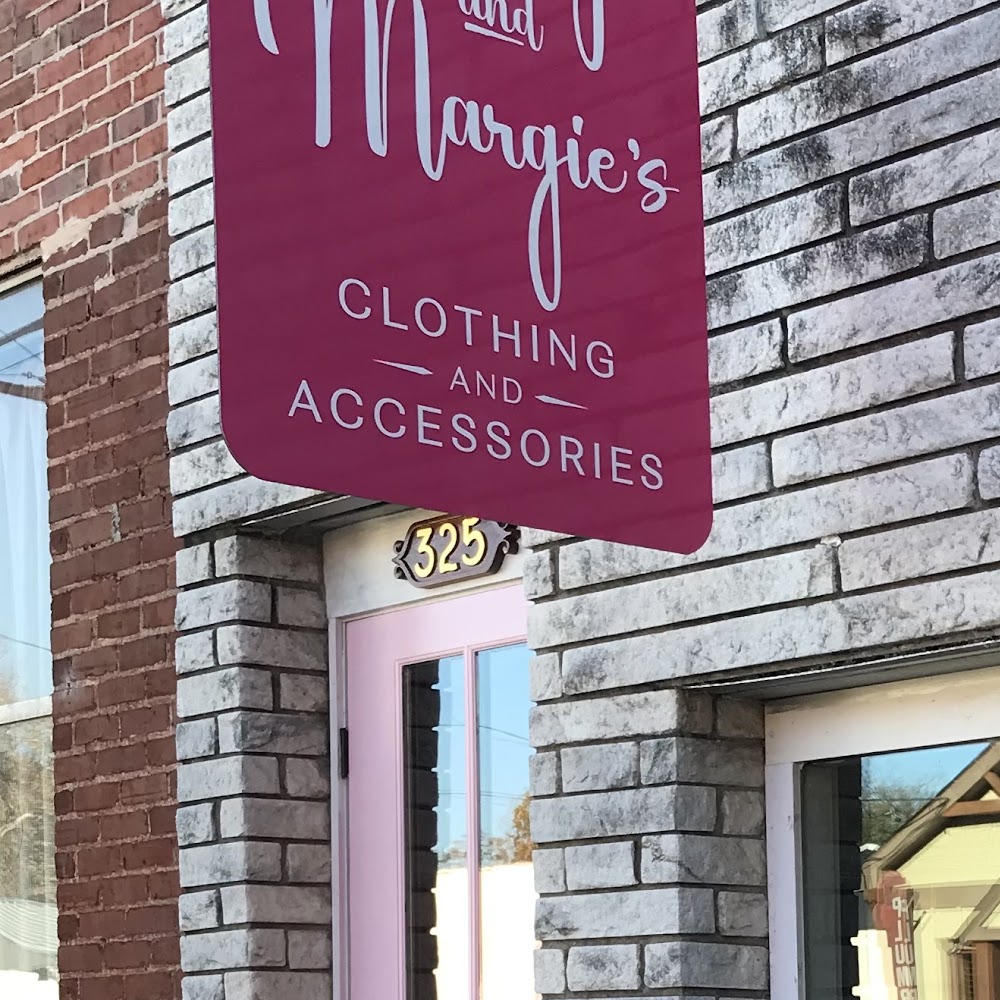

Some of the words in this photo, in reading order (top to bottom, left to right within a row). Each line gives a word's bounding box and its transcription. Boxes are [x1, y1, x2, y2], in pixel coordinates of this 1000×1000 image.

[338, 278, 616, 379] CLOTHING
[449, 366, 523, 405] AND
[288, 379, 664, 491] ACCESSORIES
[414, 516, 486, 578] 325
